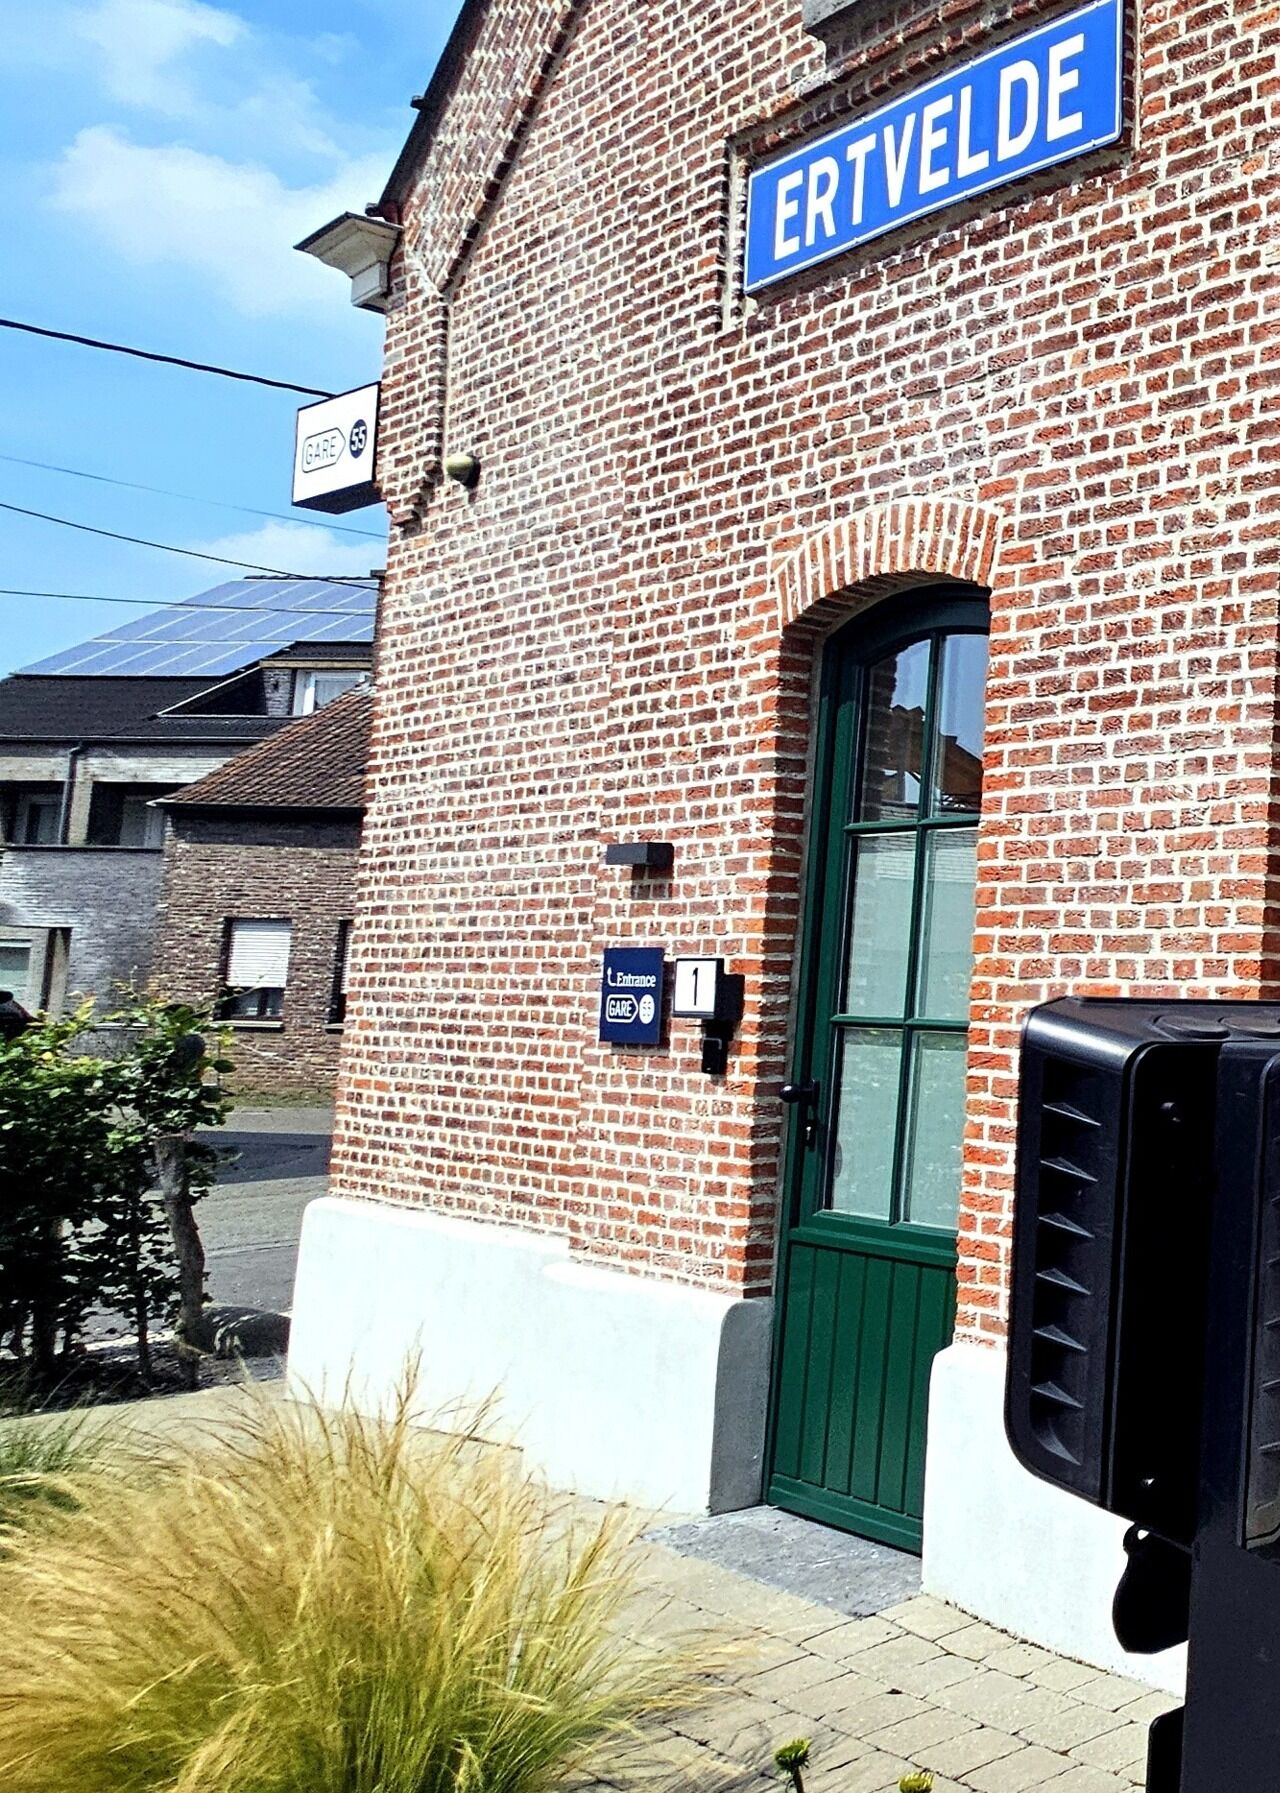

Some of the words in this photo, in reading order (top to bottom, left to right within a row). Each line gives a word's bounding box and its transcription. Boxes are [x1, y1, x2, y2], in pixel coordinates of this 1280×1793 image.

[774, 33, 1085, 261] ERTVELDE
[306, 436, 337, 465] GARE
[350, 425, 367, 452] 55
[616, 972, 657, 988] Entrance
[692, 967, 699, 1006] 1
[609, 1000, 633, 1017] GARE
